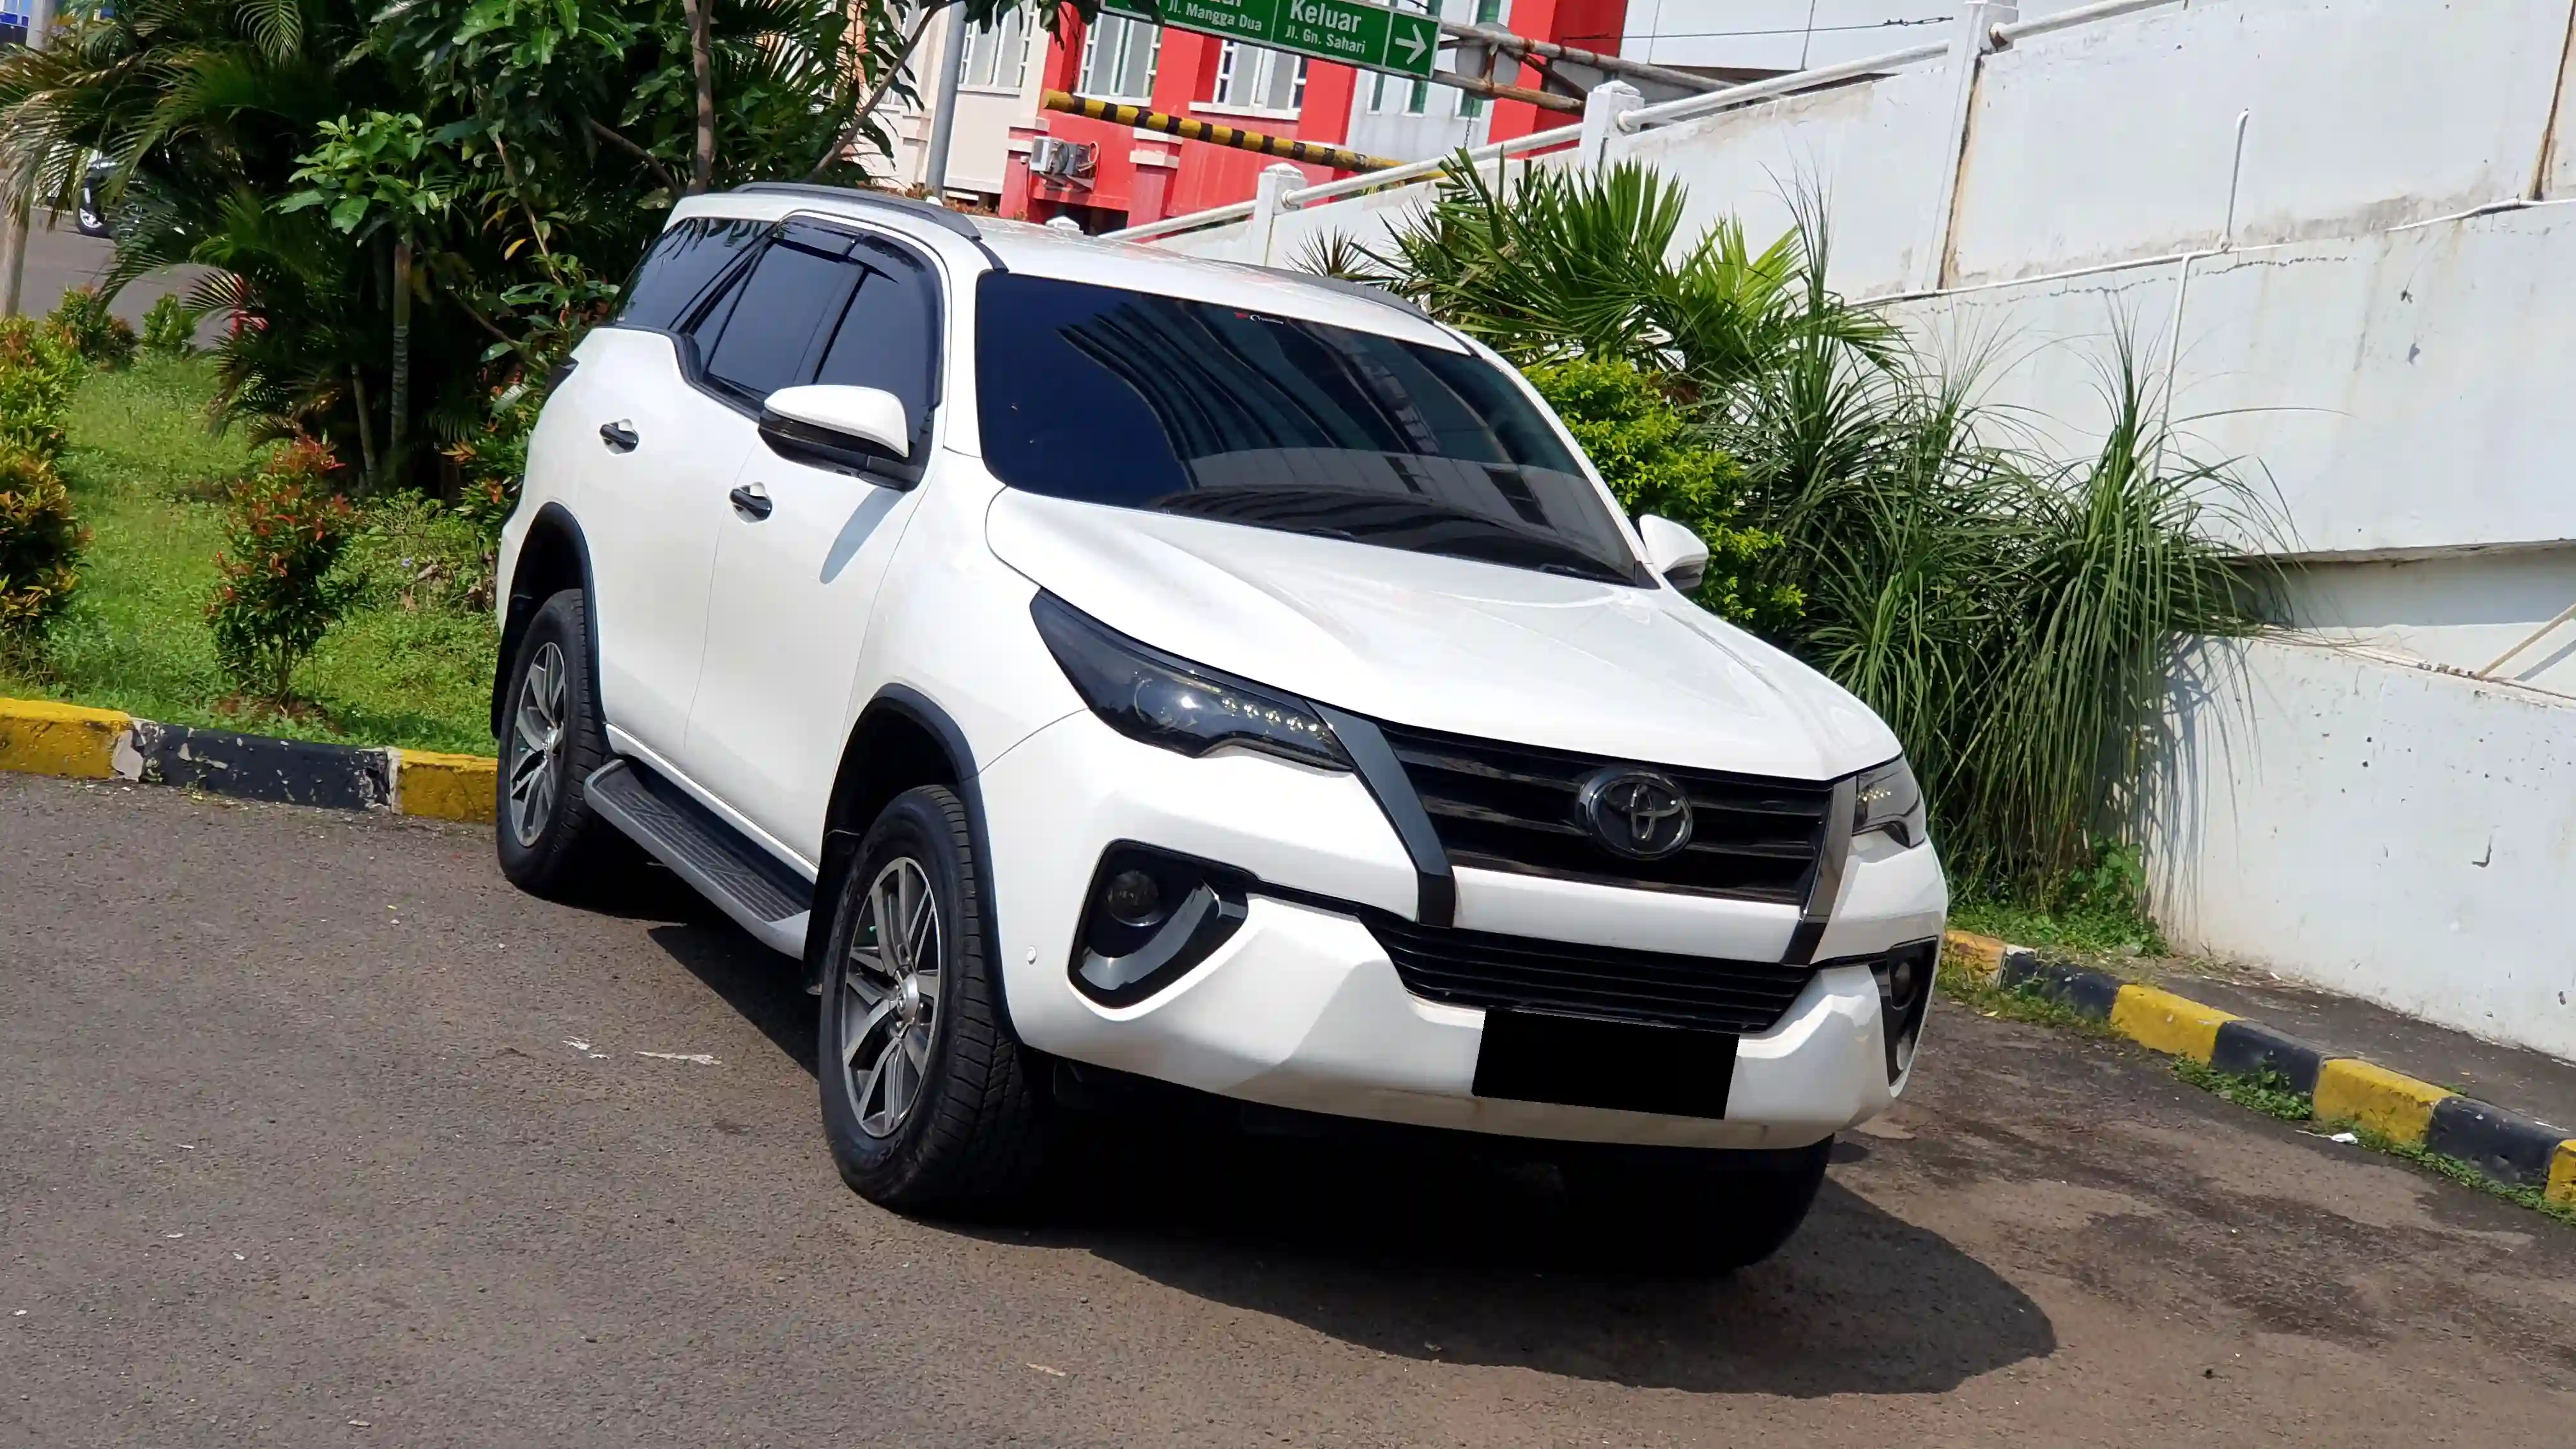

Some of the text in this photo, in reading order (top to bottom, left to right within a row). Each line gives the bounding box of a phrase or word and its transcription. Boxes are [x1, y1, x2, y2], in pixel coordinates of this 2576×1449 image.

[1167, 0, 1181, 14] Jl.
[1186, 3, 1235, 27] Mangga
[1239, 14, 1262, 31] Dua
[1291, 0, 1361, 33] Keluar
[1285, 25, 1366, 54] Jl. Gn. Sahari
